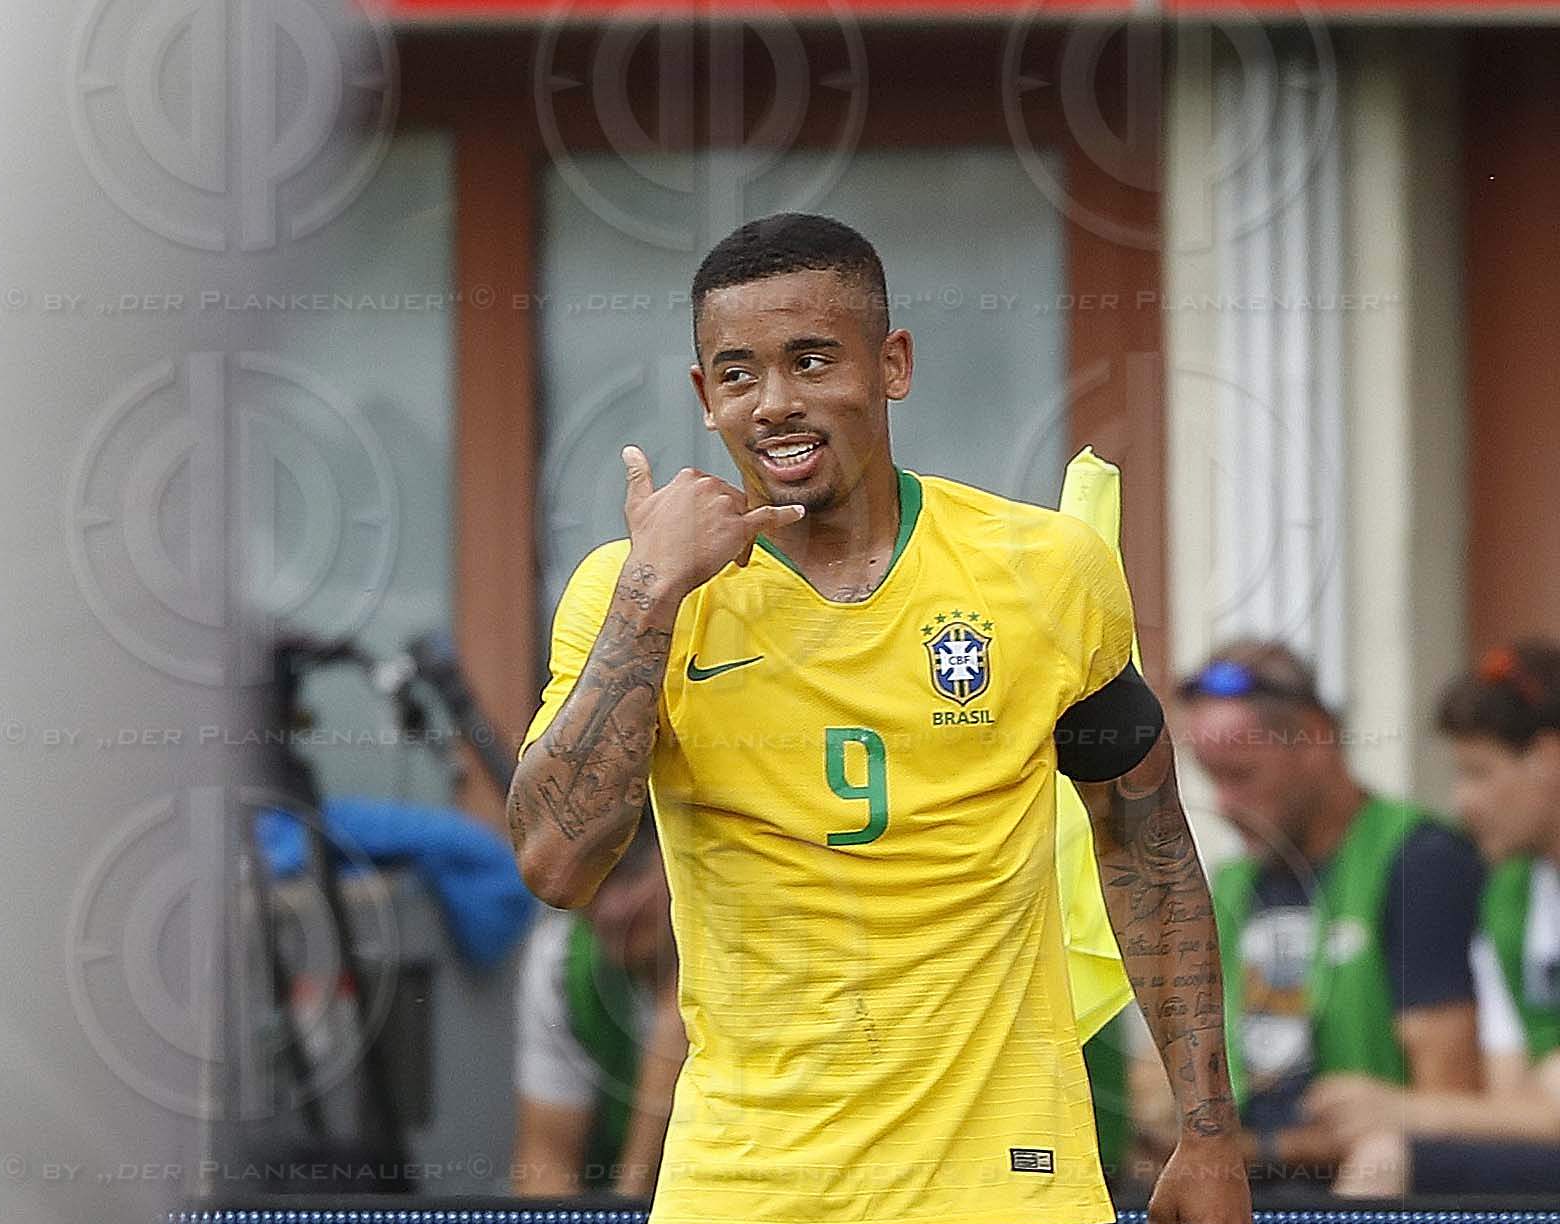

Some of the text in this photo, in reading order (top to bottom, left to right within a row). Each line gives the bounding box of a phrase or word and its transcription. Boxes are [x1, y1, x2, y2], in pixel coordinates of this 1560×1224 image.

[948, 654, 972, 667] CBF
[932, 709, 996, 726] BRASIL
[824, 726, 890, 847] 9
